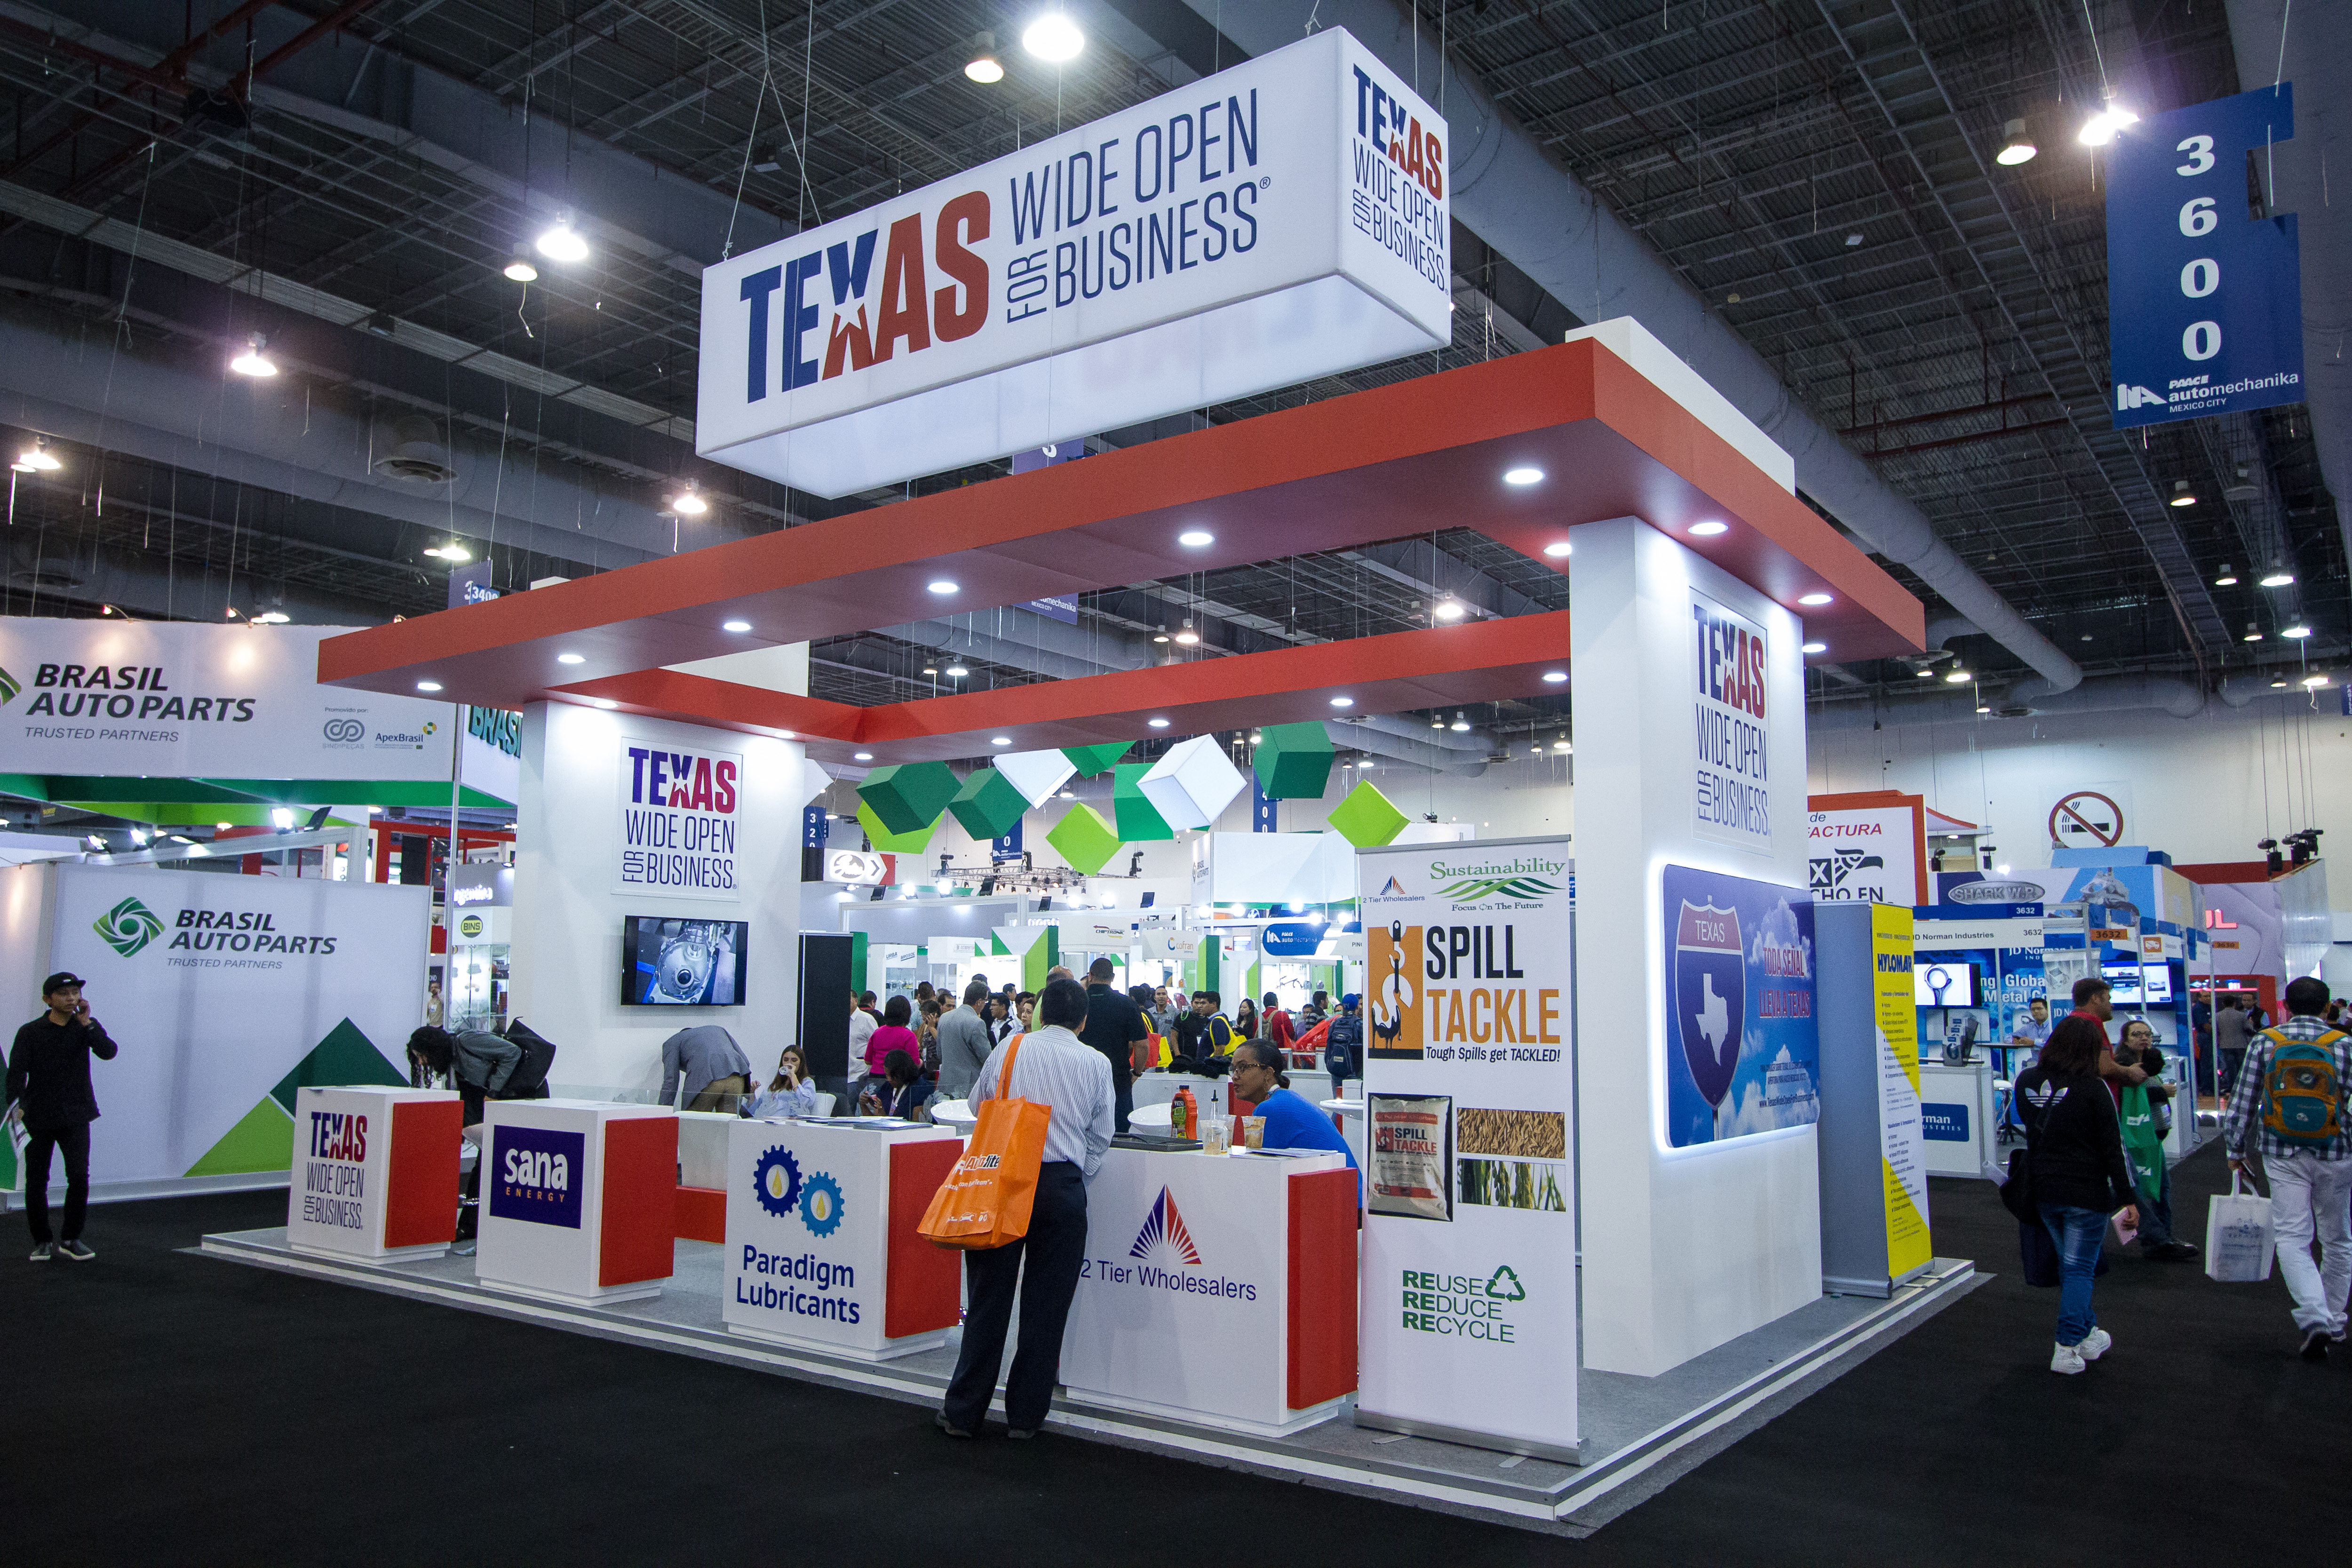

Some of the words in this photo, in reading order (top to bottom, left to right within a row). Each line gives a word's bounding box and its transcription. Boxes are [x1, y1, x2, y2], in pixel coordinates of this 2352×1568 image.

[1353, 63, 1442, 200] TEXAS
[1010, 139, 1119, 245] WIDE
[1135, 89, 1257, 203] OPEN
[1353, 138, 1397, 212] WIDE
[1403, 181, 1443, 250] OPEN
[1353, 189, 1370, 235] FOR
[2176, 135, 2221, 361] 3600
[740, 191, 991, 404] TEXAS
[1007, 249, 1047, 323] FOR
[2169, 375, 2209, 389] PAACE
[2169, 373, 2298, 402] automechanika
[2169, 401, 2204, 413] MEXICO
[2206, 398, 2226, 409] CITY
[1694, 604, 1765, 720] TEXAS
[34, 663, 168, 692] BRASIL
[26, 692, 255, 722] AUTOPARTS
[25, 727, 95, 740] TRUSTED
[99, 729, 179, 742] PARTNERS
[376, 733, 423, 743] ApexBrasil
[1696, 703, 1731, 770] WIDE
[1735, 719, 1767, 782] OPEN
[628, 747, 736, 814] TEXAS
[1698, 770, 1712, 821] FOR
[626, 809, 678, 849] WIDE
[684, 816, 735, 854] OPEN
[1810, 812, 1826, 822] de
[623, 851, 644, 883] FOR
[1430, 858, 1566, 880] Sustainability
[1955, 886, 2004, 900] SHARK
[175, 909, 276, 931] BRASIL
[1695, 920, 1725, 943] TEXAS
[169, 931, 337, 955] AUTOPARTS
[1176, 941, 1193, 949] cofran
[1426, 924, 1524, 980] SPILL
[167, 958, 221, 968] TRUSTED
[224, 959, 283, 970] PARTNERS
[1763, 947, 1782, 976] TODA
[1783, 945, 1804, 977] SEÑAL
[1877, 953, 1913, 973] HYLOMAR
[1759, 989, 1781, 1019] LLEVA
[1782, 990, 1788, 1018] A
[1788, 990, 1811, 1019] TEXAS
[1984, 990, 2027, 1002] Metal
[1426, 988, 1560, 1044] TACKLE
[1426, 1046, 1454, 1060] Tough
[1458, 1047, 1486, 1062] Spills
[1490, 1049, 1507, 1062] get
[1510, 1049, 1560, 1062] TACKLED!
[311, 1111, 367, 1163] TEXAS
[1395, 1128, 1427, 1140] SPILL
[1395, 1139, 1437, 1153] TACKLE
[307, 1162, 334, 1194] WIDE
[335, 1165, 364, 1198] OPEN
[504, 1148, 568, 1191] sana
[303, 1195, 315, 1222] FOR
[506, 1187, 565, 1202] ENERGY
[743, 1245, 854, 1291] Paradigm
[1081, 1259, 1091, 1279] 2
[1097, 1261, 1132, 1285] Tier
[1138, 1266, 1257, 1301] Wholesalers
[1403, 1270, 1483, 1297] REUSE
[737, 1277, 860, 1325] Lubricants
[1403, 1290, 1503, 1321] REDUCE
[1403, 1311, 1515, 1344] RECYCLE
